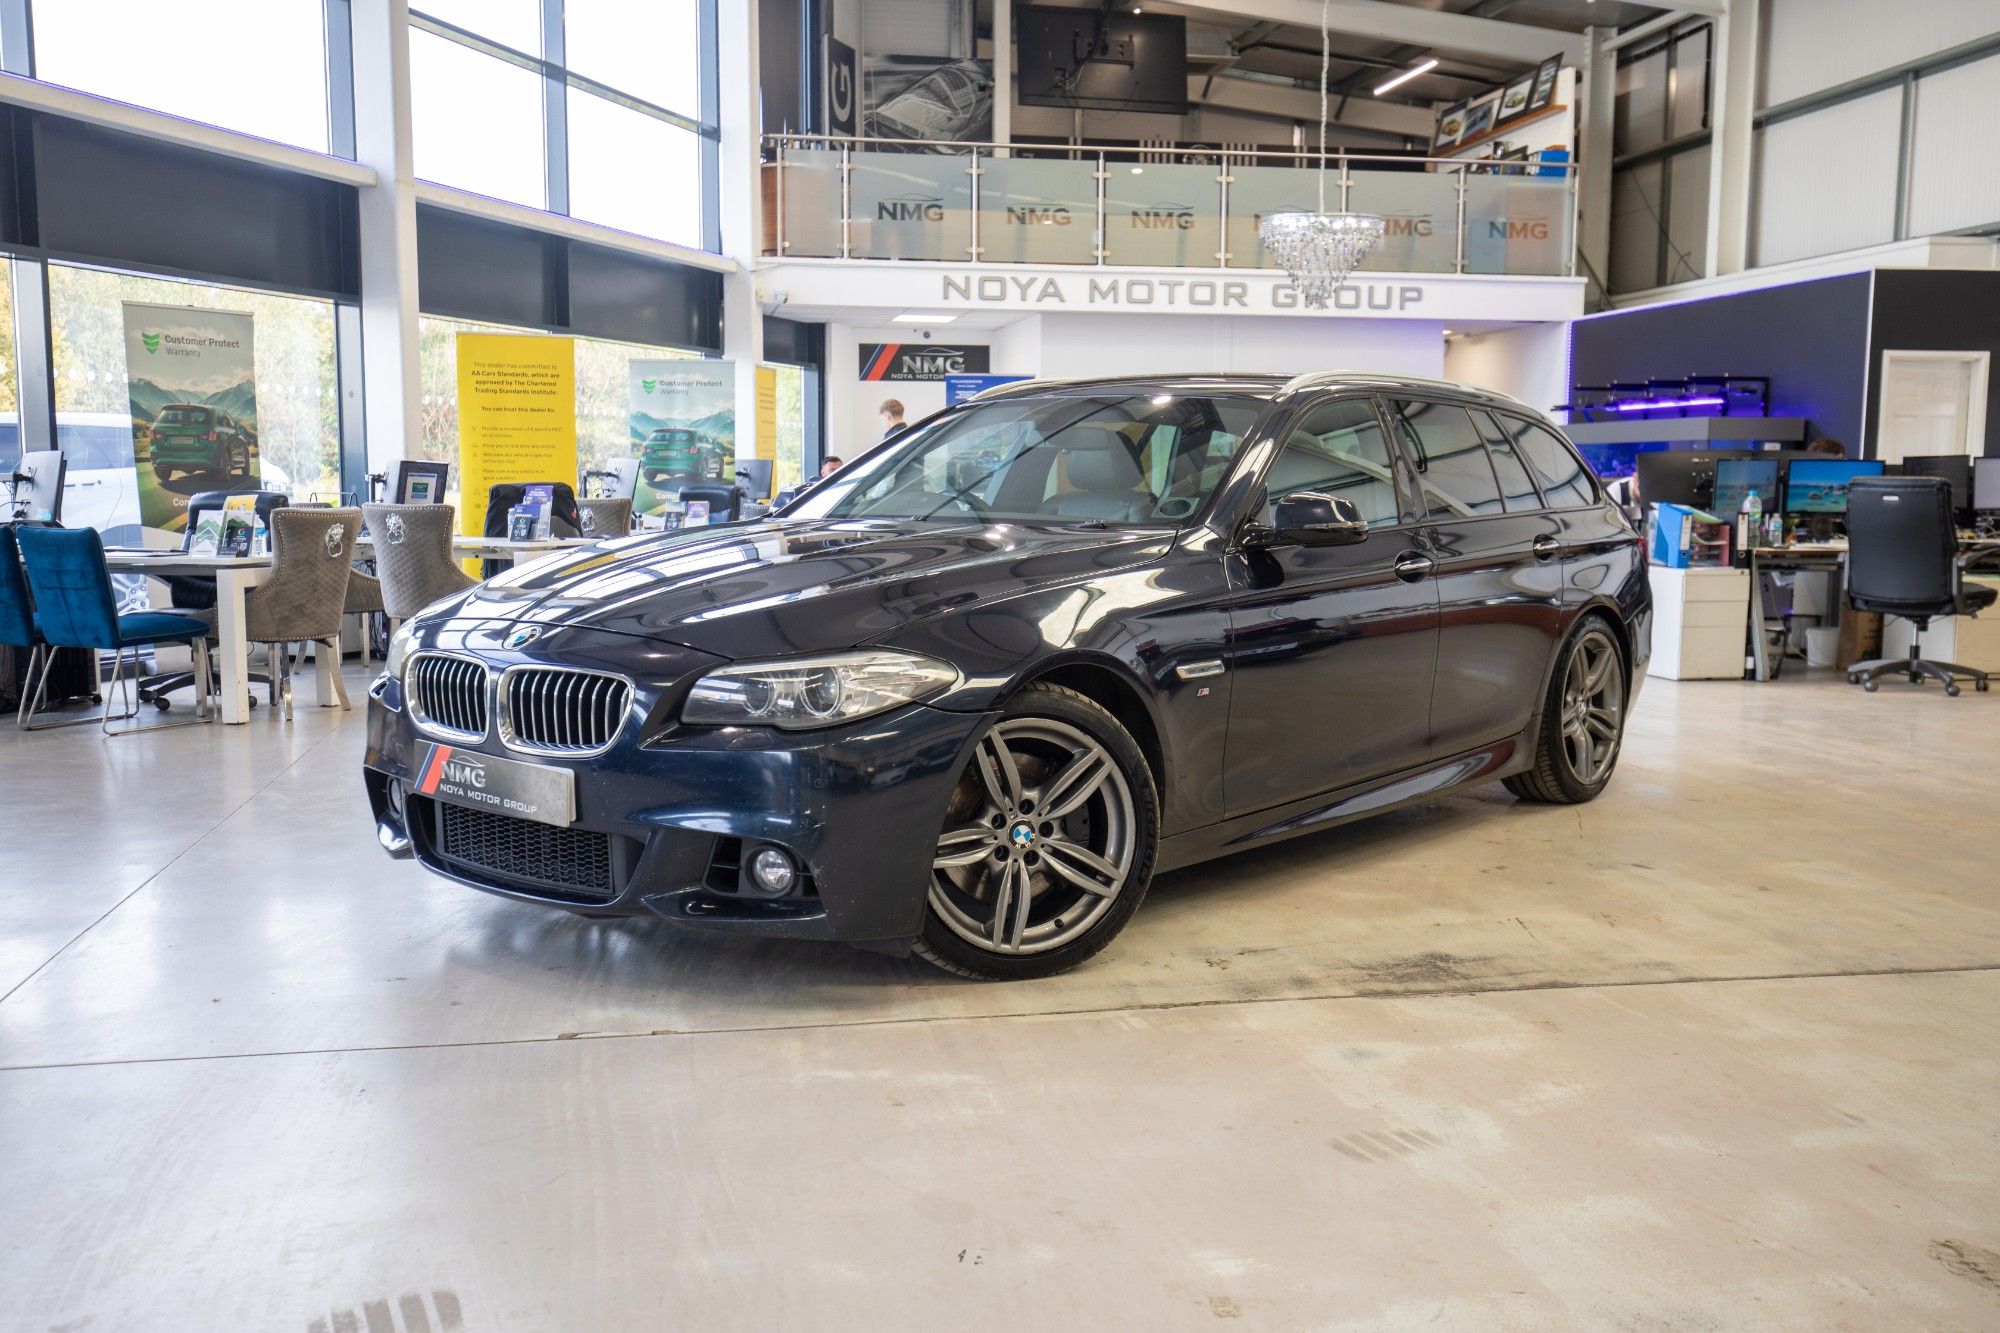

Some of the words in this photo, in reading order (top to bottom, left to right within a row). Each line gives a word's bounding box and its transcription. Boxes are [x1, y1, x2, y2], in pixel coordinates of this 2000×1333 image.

[877, 202, 944, 221] NMG
[1006, 206, 1072, 226] NMG
[1132, 211, 1196, 230] NMG
[1489, 221, 1549, 240] NMG
[942, 275, 1066, 302] NOYA
[1089, 278, 1248, 306] MOTOR
[1272, 284, 1424, 310] GOUP
[164, 335, 206, 346] Customer
[208, 338, 240, 348] Protect
[165, 347, 201, 358] Warranty
[902, 355, 966, 373] NMG
[891, 372, 913, 380] NOYA
[440, 761, 486, 788] NMG
[440, 784, 465, 797] NOYA
[467, 789, 500, 806] MOTOR
[503, 796, 538, 814] GROUP
